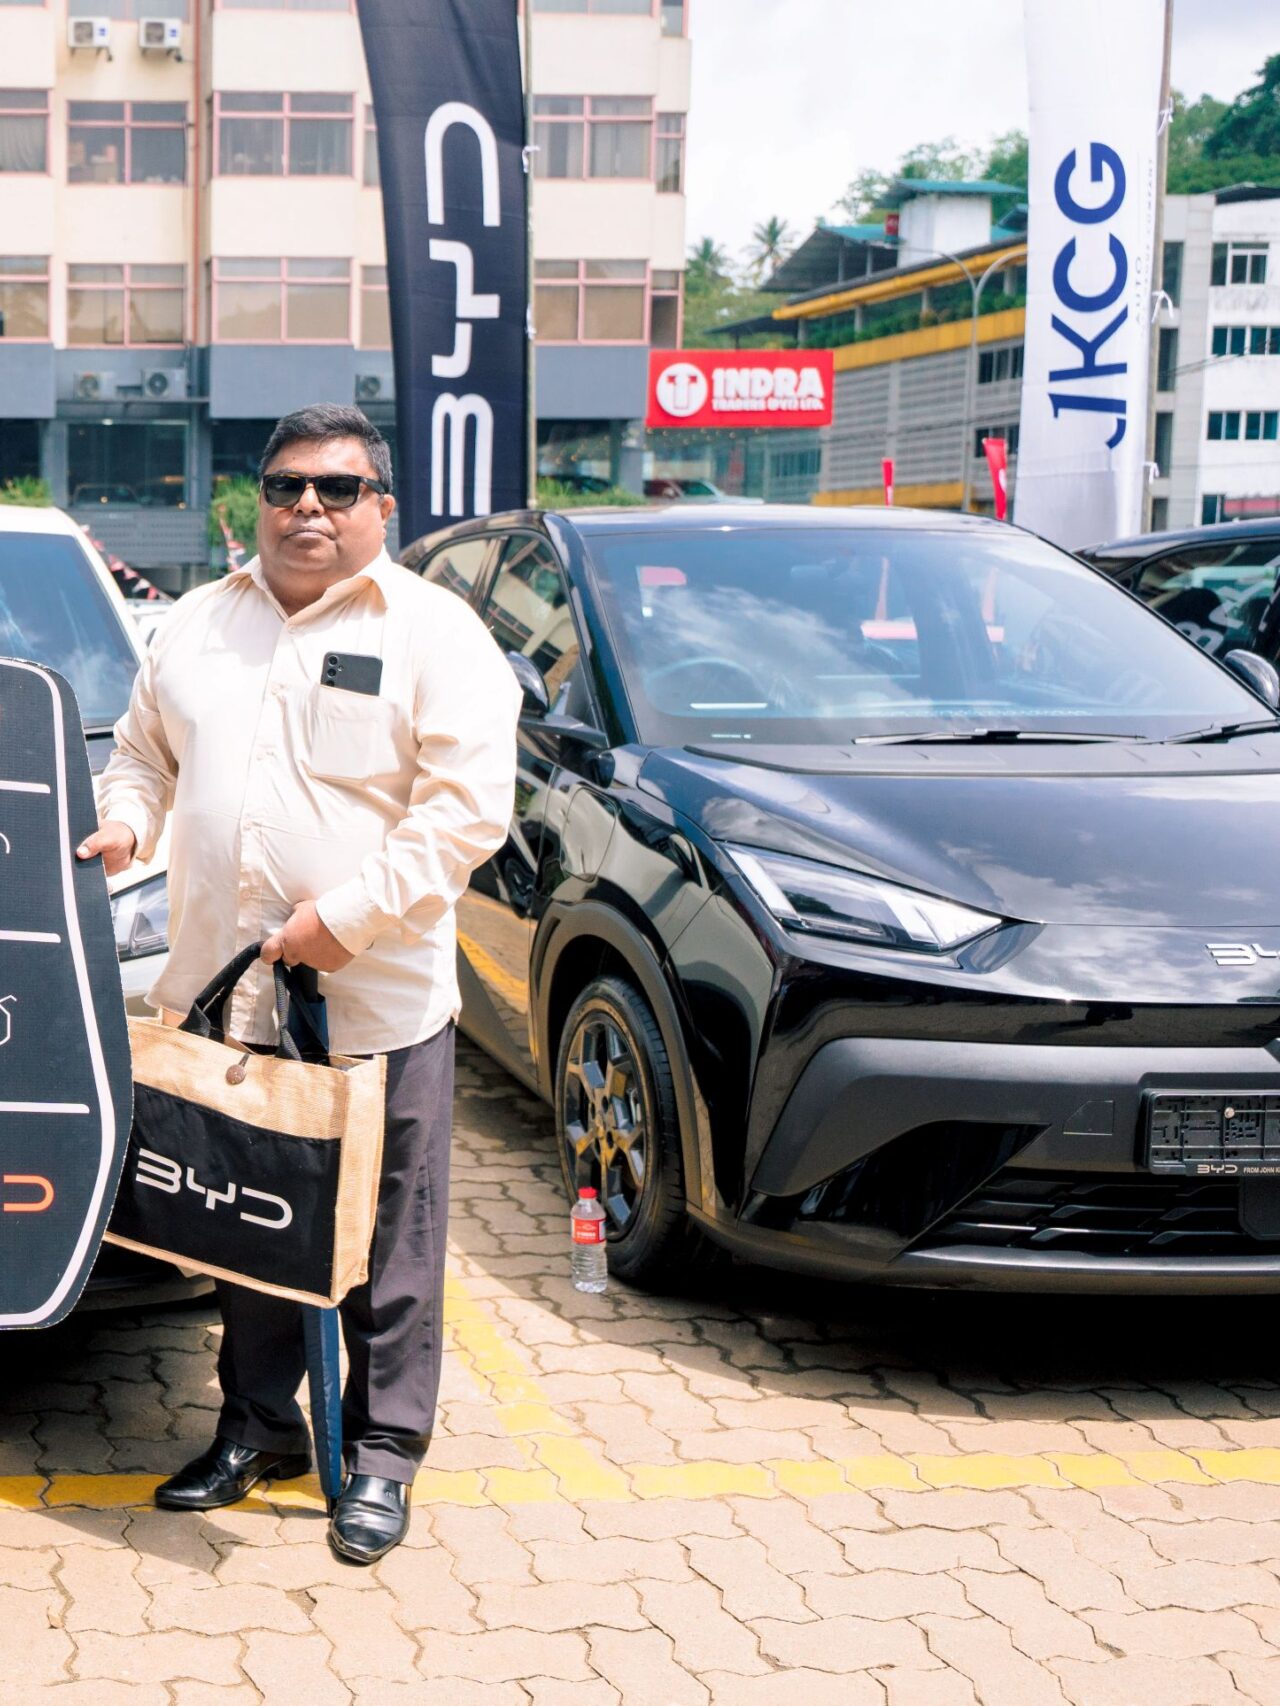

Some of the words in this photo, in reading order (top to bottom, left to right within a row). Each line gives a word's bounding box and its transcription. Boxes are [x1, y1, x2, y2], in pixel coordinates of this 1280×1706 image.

[424, 101, 501, 517] BYD
[1047, 142, 1128, 450] JKCG
[712, 367, 825, 398] INDRA
[135, 1148, 293, 1229] BYD
[1197, 1164, 1238, 1174] BYD
[1243, 1166, 1259, 1174] FROM
[1259, 1166, 1275, 1174] JOHN
